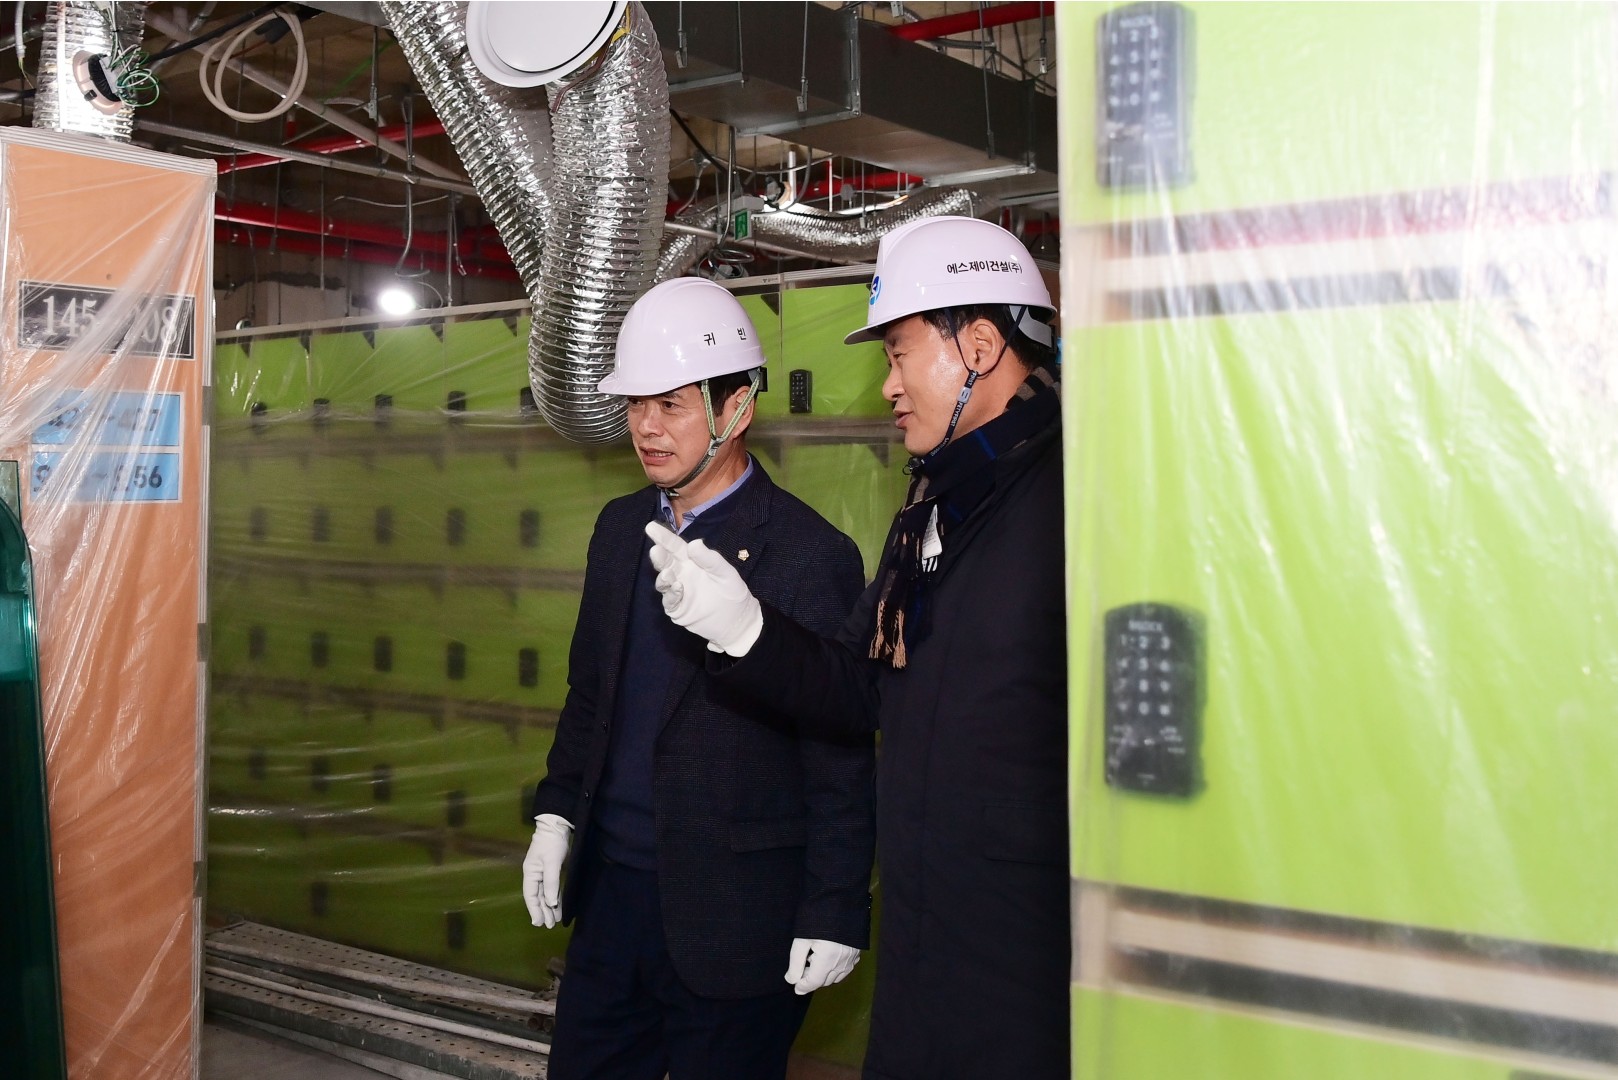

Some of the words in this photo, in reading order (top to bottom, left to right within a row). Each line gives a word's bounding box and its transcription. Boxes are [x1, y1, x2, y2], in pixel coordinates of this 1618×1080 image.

[946, 260, 1022, 274] 에스제이건설(주)
[703, 332, 716, 346] 귀
[736, 327, 747, 341] 빈
